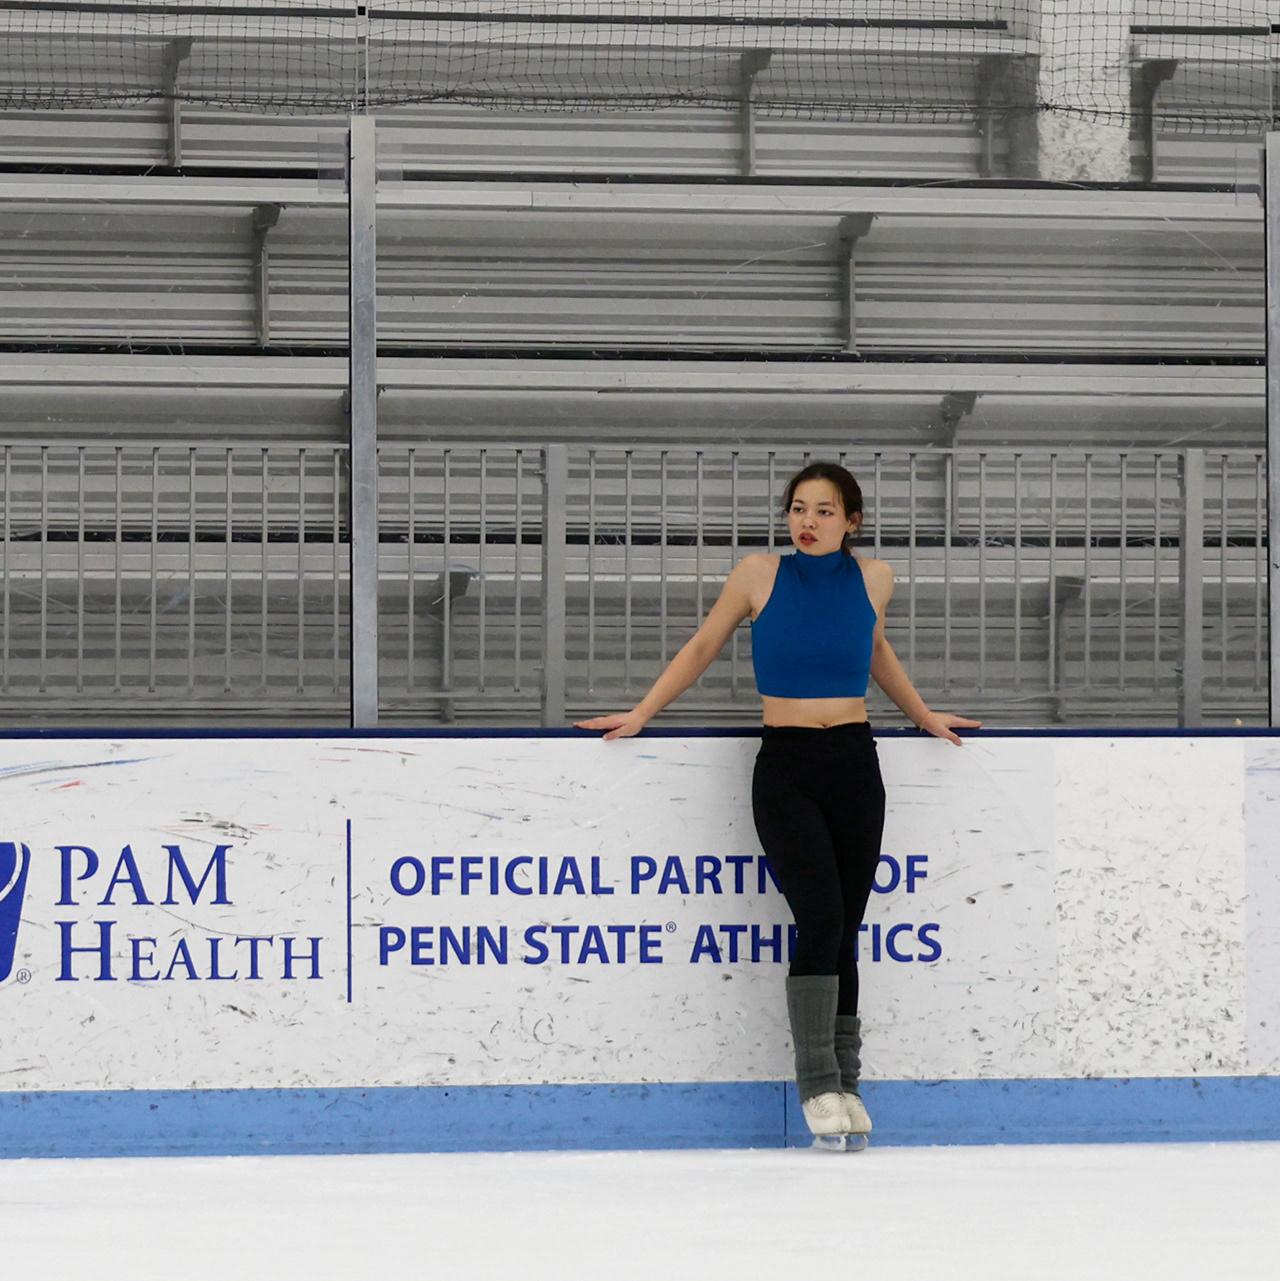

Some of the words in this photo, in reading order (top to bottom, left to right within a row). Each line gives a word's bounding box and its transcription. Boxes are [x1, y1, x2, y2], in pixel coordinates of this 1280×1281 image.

[55, 845, 234, 906] PAM
[390, 855, 615, 897] OFFICIAL
[631, 855, 785, 895] PARTN
[871, 854, 929, 895] OF
[54, 920, 324, 982] HEALTH
[379, 925, 508, 966] PENN
